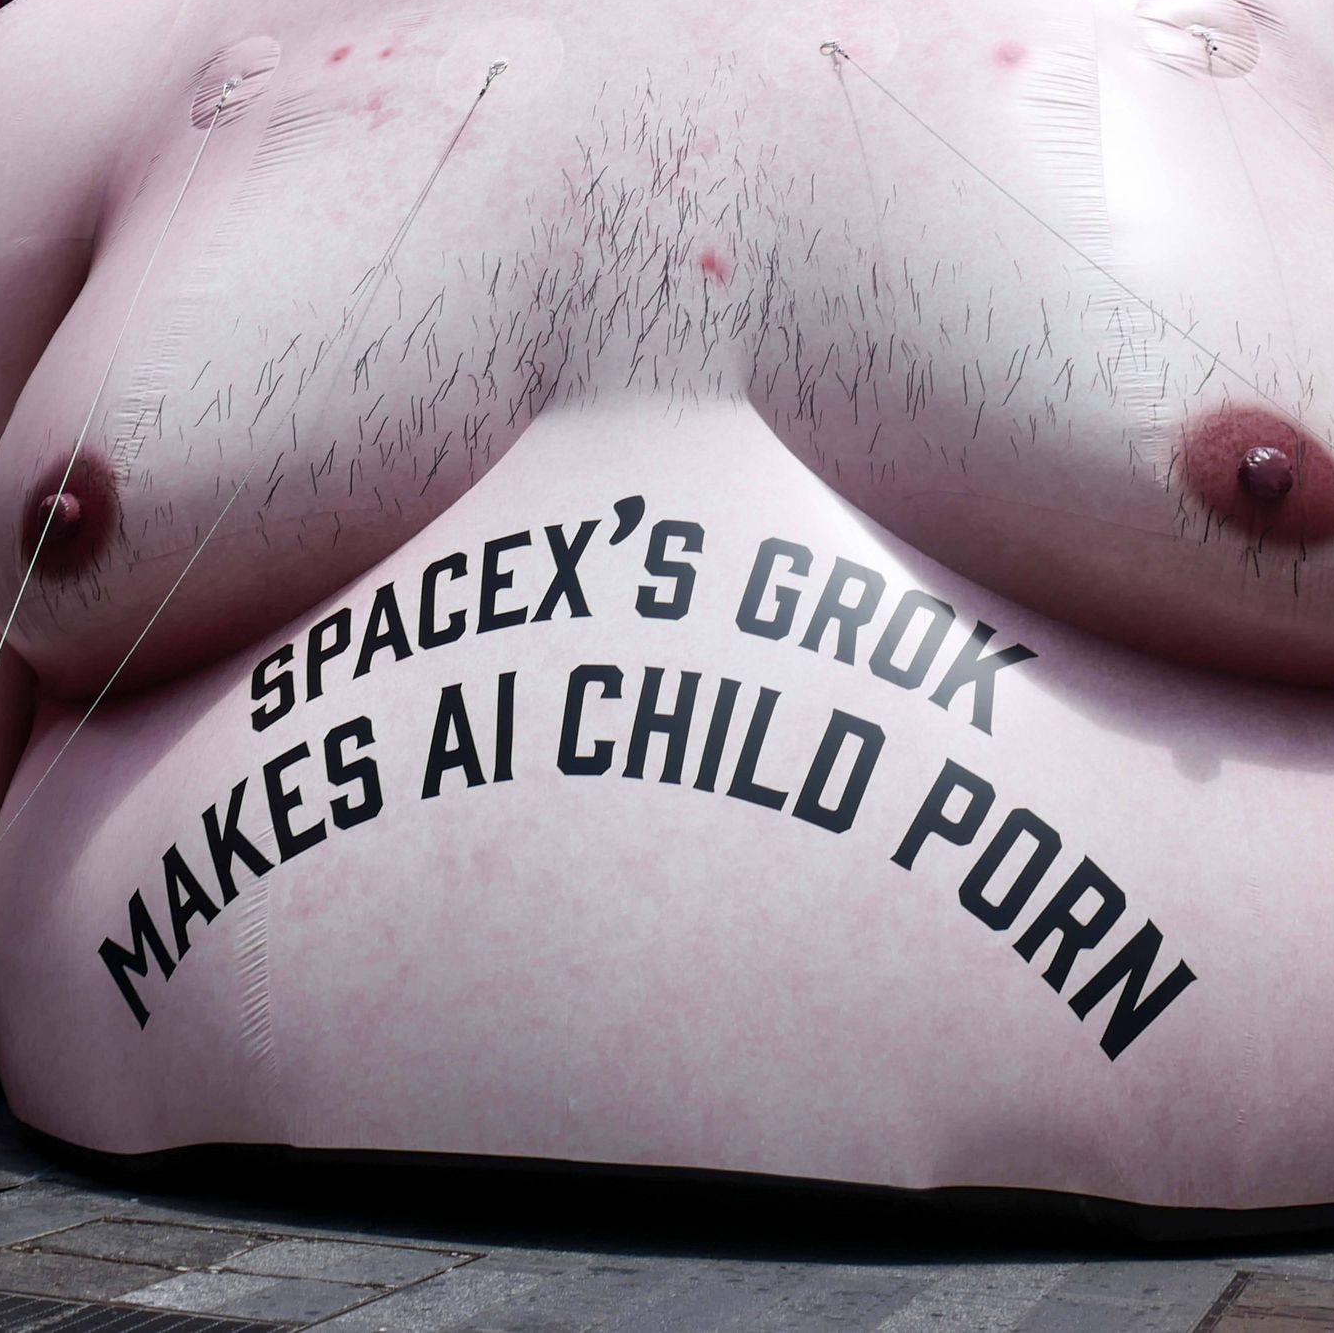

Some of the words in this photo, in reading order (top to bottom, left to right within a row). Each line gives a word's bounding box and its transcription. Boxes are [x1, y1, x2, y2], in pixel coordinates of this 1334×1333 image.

[251, 495, 704, 732] SPACEX'S
[735, 535, 1038, 736] GROK
[97, 713, 384, 1030] MAKES
[422, 671, 517, 800] AI
[557, 662, 886, 834] CHILD
[892, 757, 1198, 1063] PORN
